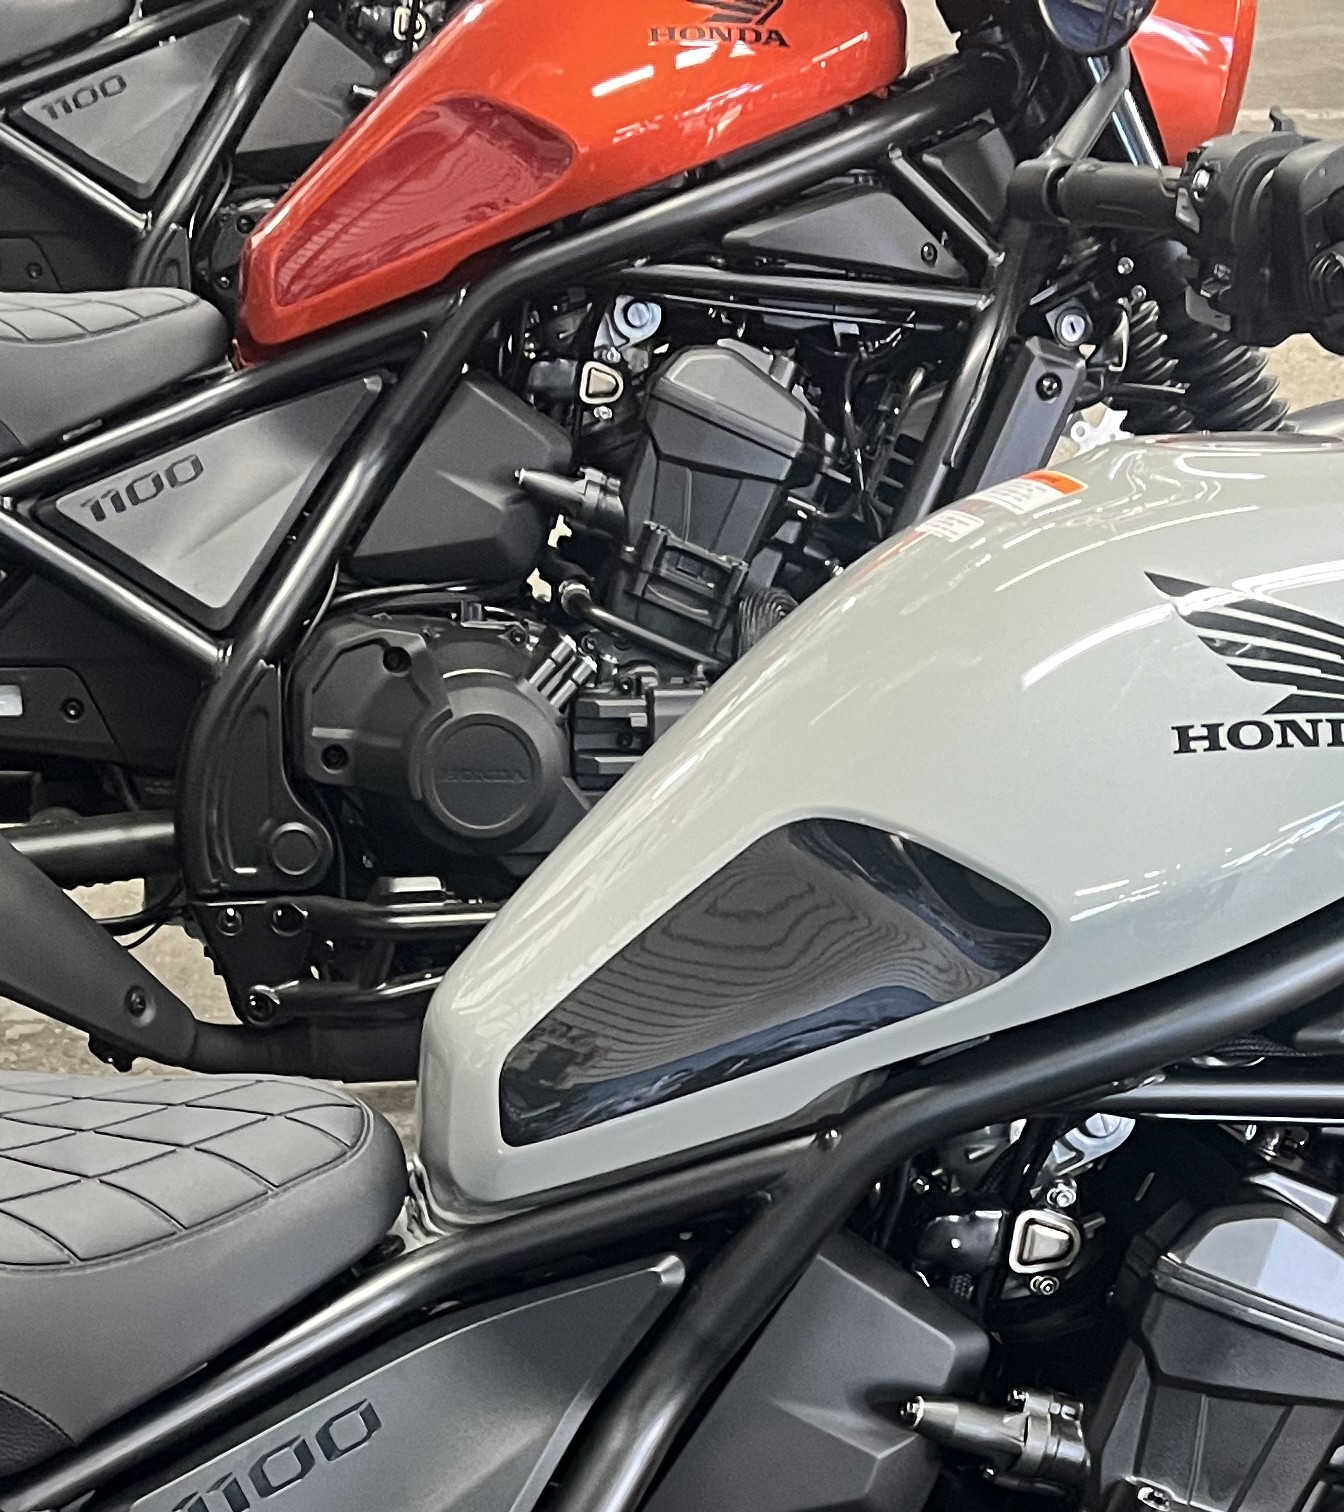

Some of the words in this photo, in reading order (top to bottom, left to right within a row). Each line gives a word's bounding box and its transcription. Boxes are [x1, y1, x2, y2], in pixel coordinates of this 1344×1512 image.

[647, 26, 791, 48] HONDA
[40, 74, 127, 120] 1100
[79, 453, 205, 523] 1100
